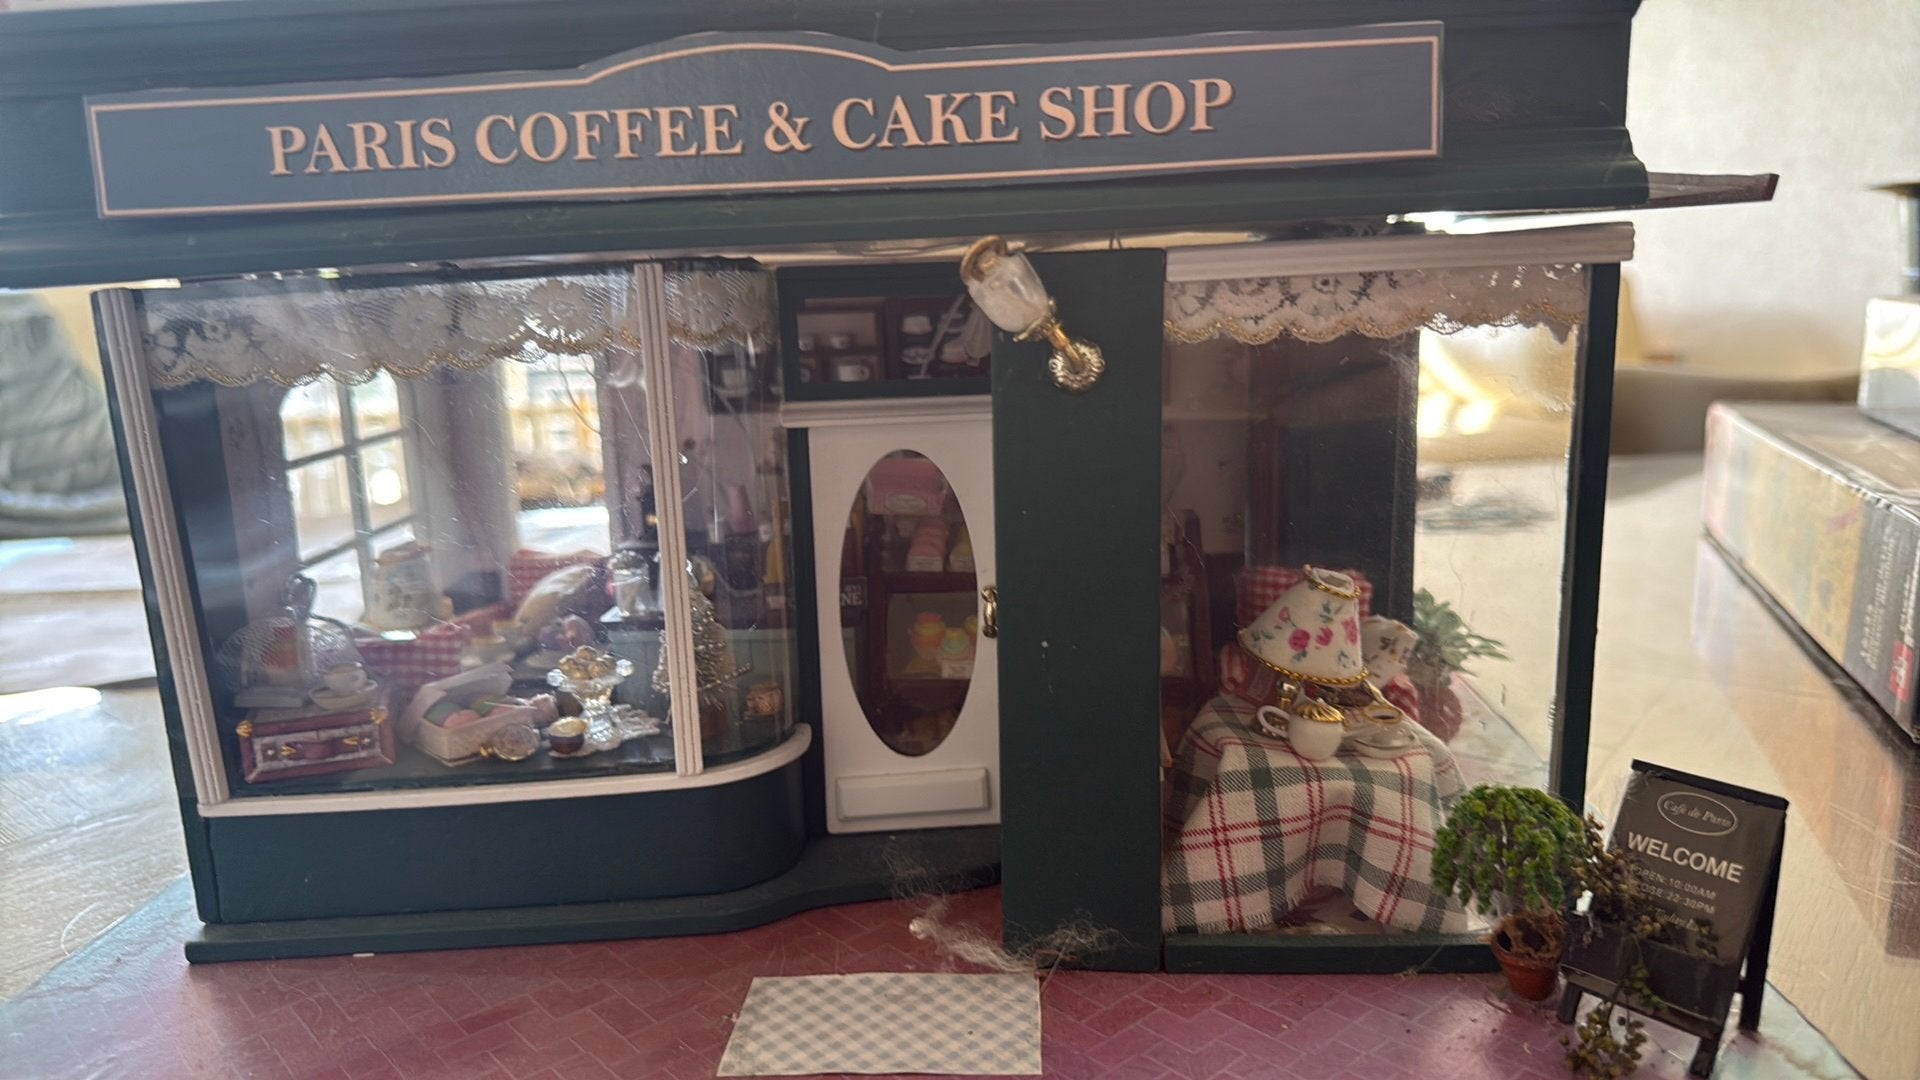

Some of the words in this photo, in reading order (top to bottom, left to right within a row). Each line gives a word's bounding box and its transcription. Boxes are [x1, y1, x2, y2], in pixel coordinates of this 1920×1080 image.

[265, 116, 457, 177] PARIS
[475, 103, 744, 166] COFFEE
[763, 101, 813, 153] &
[832, 91, 1020, 150] CAKE
[1039, 78, 1233, 141] SHOP
[1627, 831, 1744, 884] WELCOME
